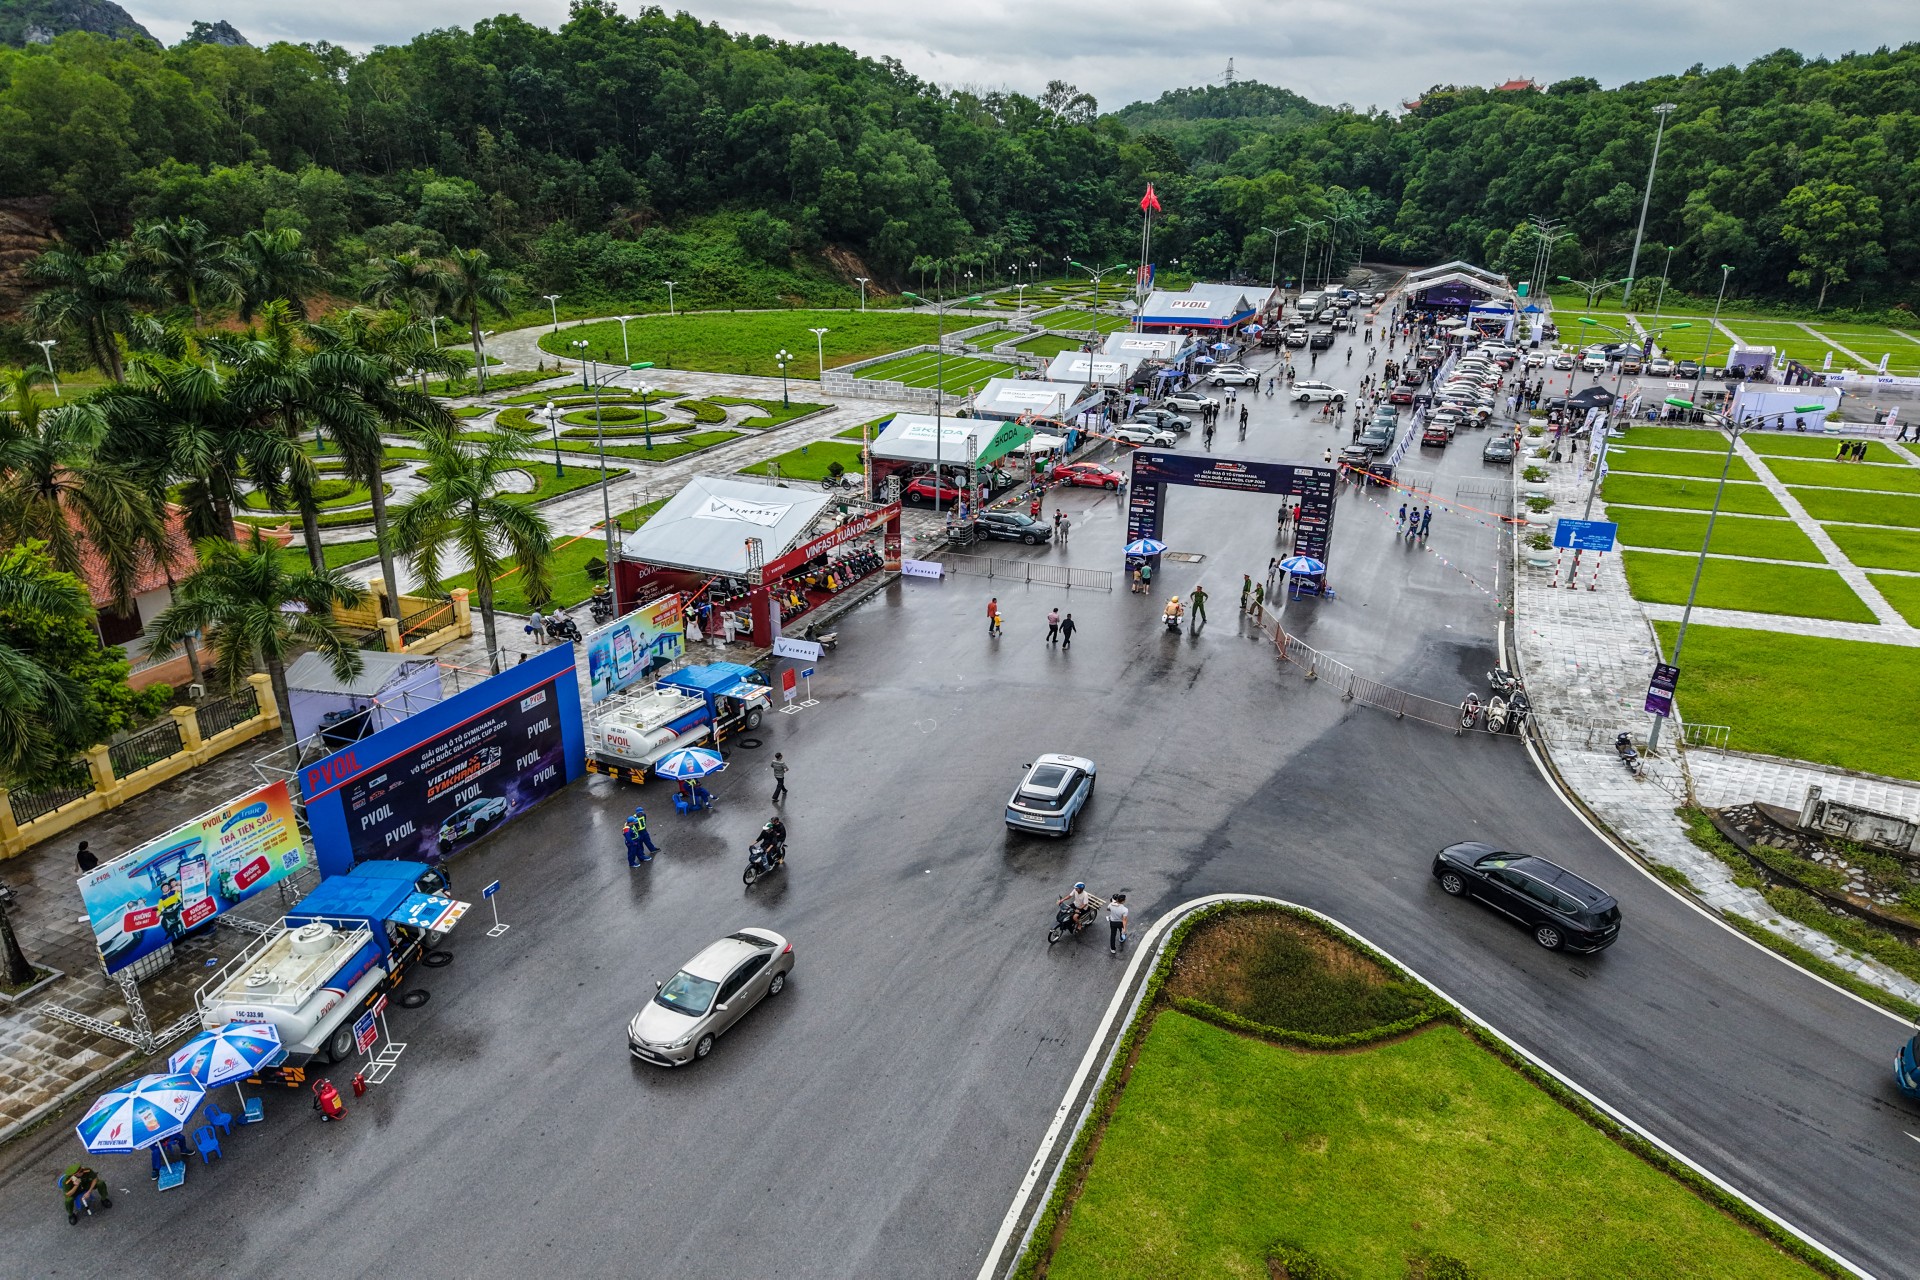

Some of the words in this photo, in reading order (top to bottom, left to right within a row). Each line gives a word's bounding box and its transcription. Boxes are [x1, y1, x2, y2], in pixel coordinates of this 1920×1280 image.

[1171, 300, 1208, 309] PVOIL
[729, 507, 779, 517] VINFAST
[805, 535, 836, 559] VINFAST
[836, 524, 857, 544] XUÂN
[856, 517, 872, 533] ĐỨC
[788, 647, 815, 656] VINFAST
[421, 750, 435, 761] GIẢI
[435, 744, 449, 754] ĐUA
[449, 739, 454, 747] Ô
[454, 735, 463, 744] TÔ
[463, 718, 496, 740] GYMKHANA
[527, 717, 552, 739] PVOIL
[607, 733, 631, 747] PVOIL
[410, 764, 420, 775] VÔ
[420, 758, 435, 771] ĐỊCH
[436, 750, 453, 762] QUỐC
[453, 744, 464, 754] GIA
[464, 735, 481, 748] PVOIL
[481, 728, 493, 739] CUP
[493, 720, 508, 732] 2025
[307, 751, 362, 792] PVOIL
[516, 749, 541, 771] PVOIL
[427, 760, 468, 788] VIETNAM
[427, 762, 481, 798] GYMKHANA
[533, 764, 557, 787] PVOIL
[427, 780, 465, 804] CHAMPIONSHIP
[454, 782, 482, 807] PVOIL
[360, 803, 394, 831] PVOIL
[219, 831, 236, 846] TRẢ
[236, 820, 255, 836] TIỀN
[256, 813, 273, 827] SAU
[384, 820, 417, 847] PVOIL
[133, 911, 152, 922] KHÔNG
[320, 1000, 336, 1017] PVOIL
